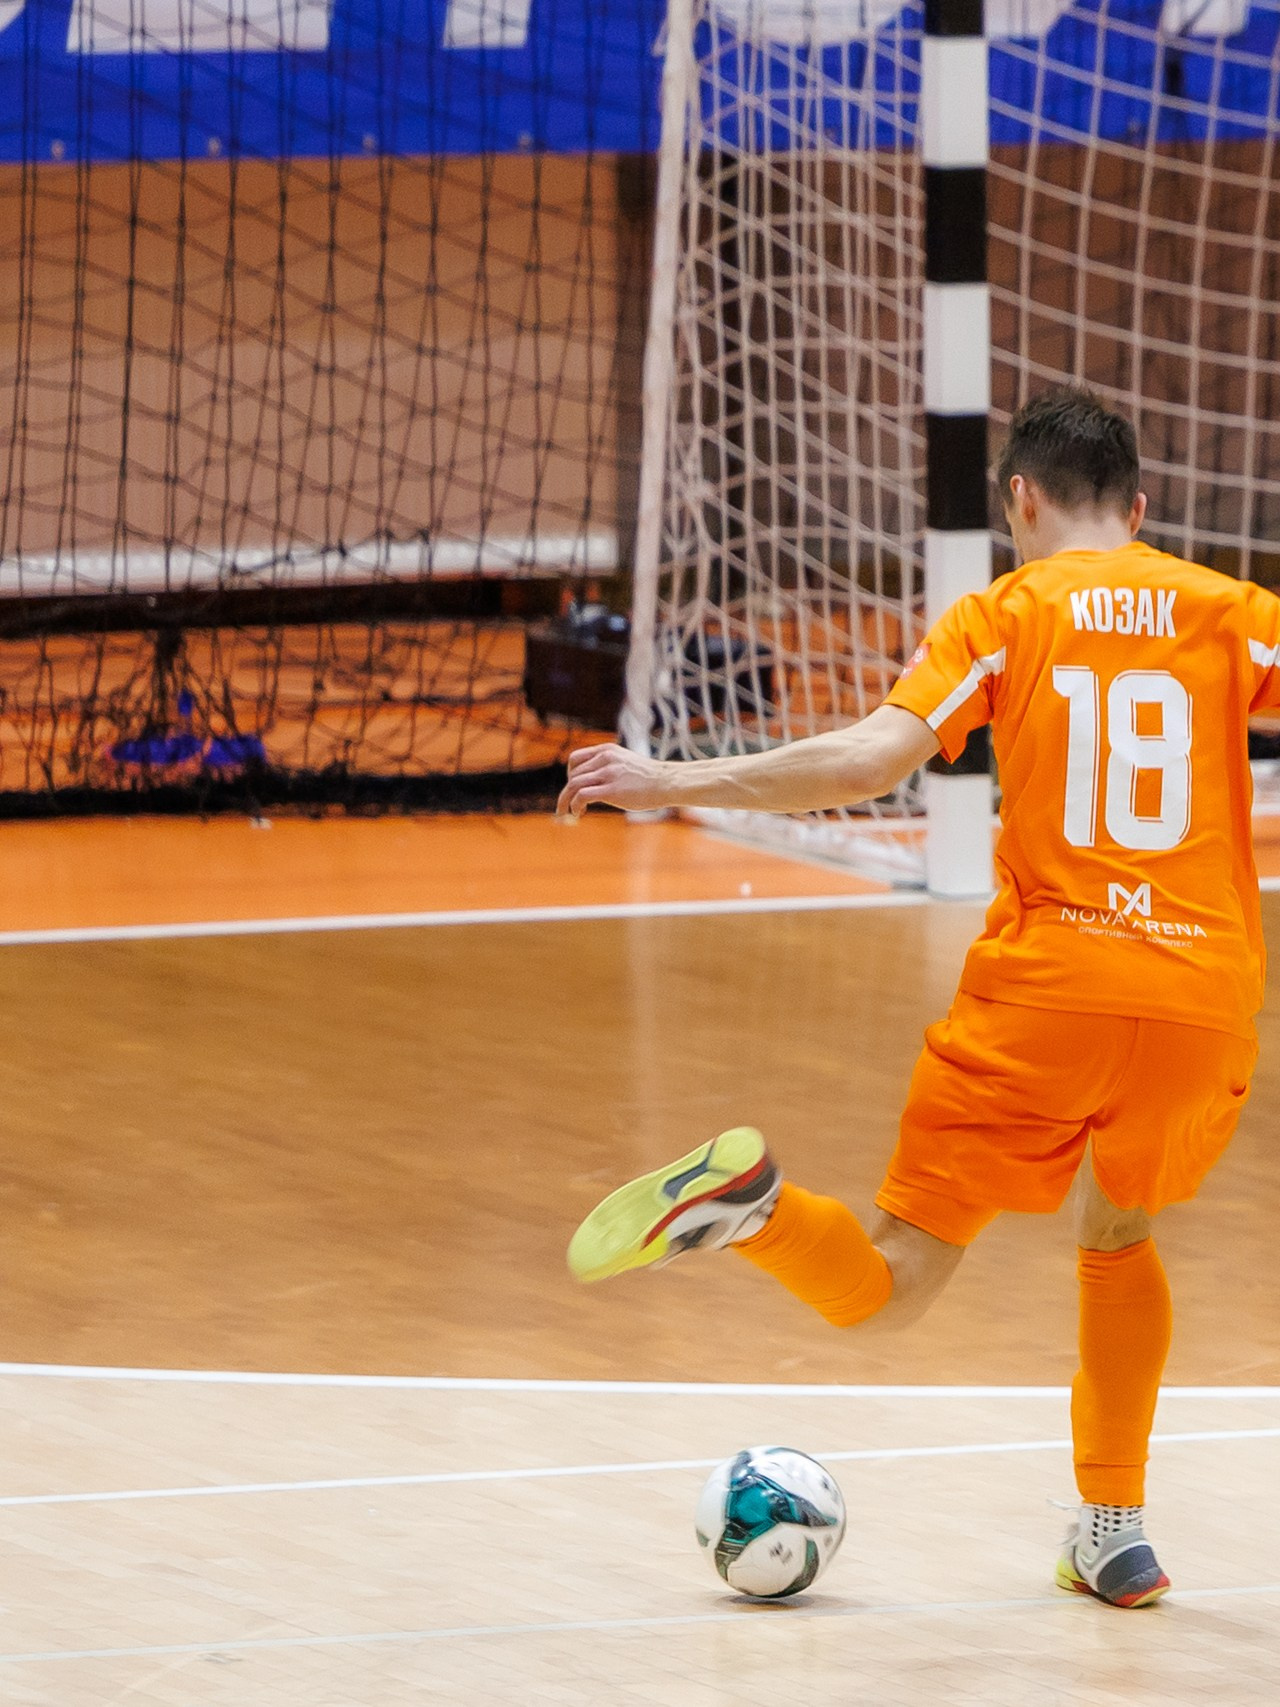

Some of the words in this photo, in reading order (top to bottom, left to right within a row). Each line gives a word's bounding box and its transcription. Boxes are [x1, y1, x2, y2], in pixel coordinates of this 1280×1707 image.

[1070, 587, 1177, 638] КОЗАК
[1052, 665, 1193, 852] 18
[1060, 907, 1126, 926] NOVA
[1132, 919, 1207, 938] ARENA
